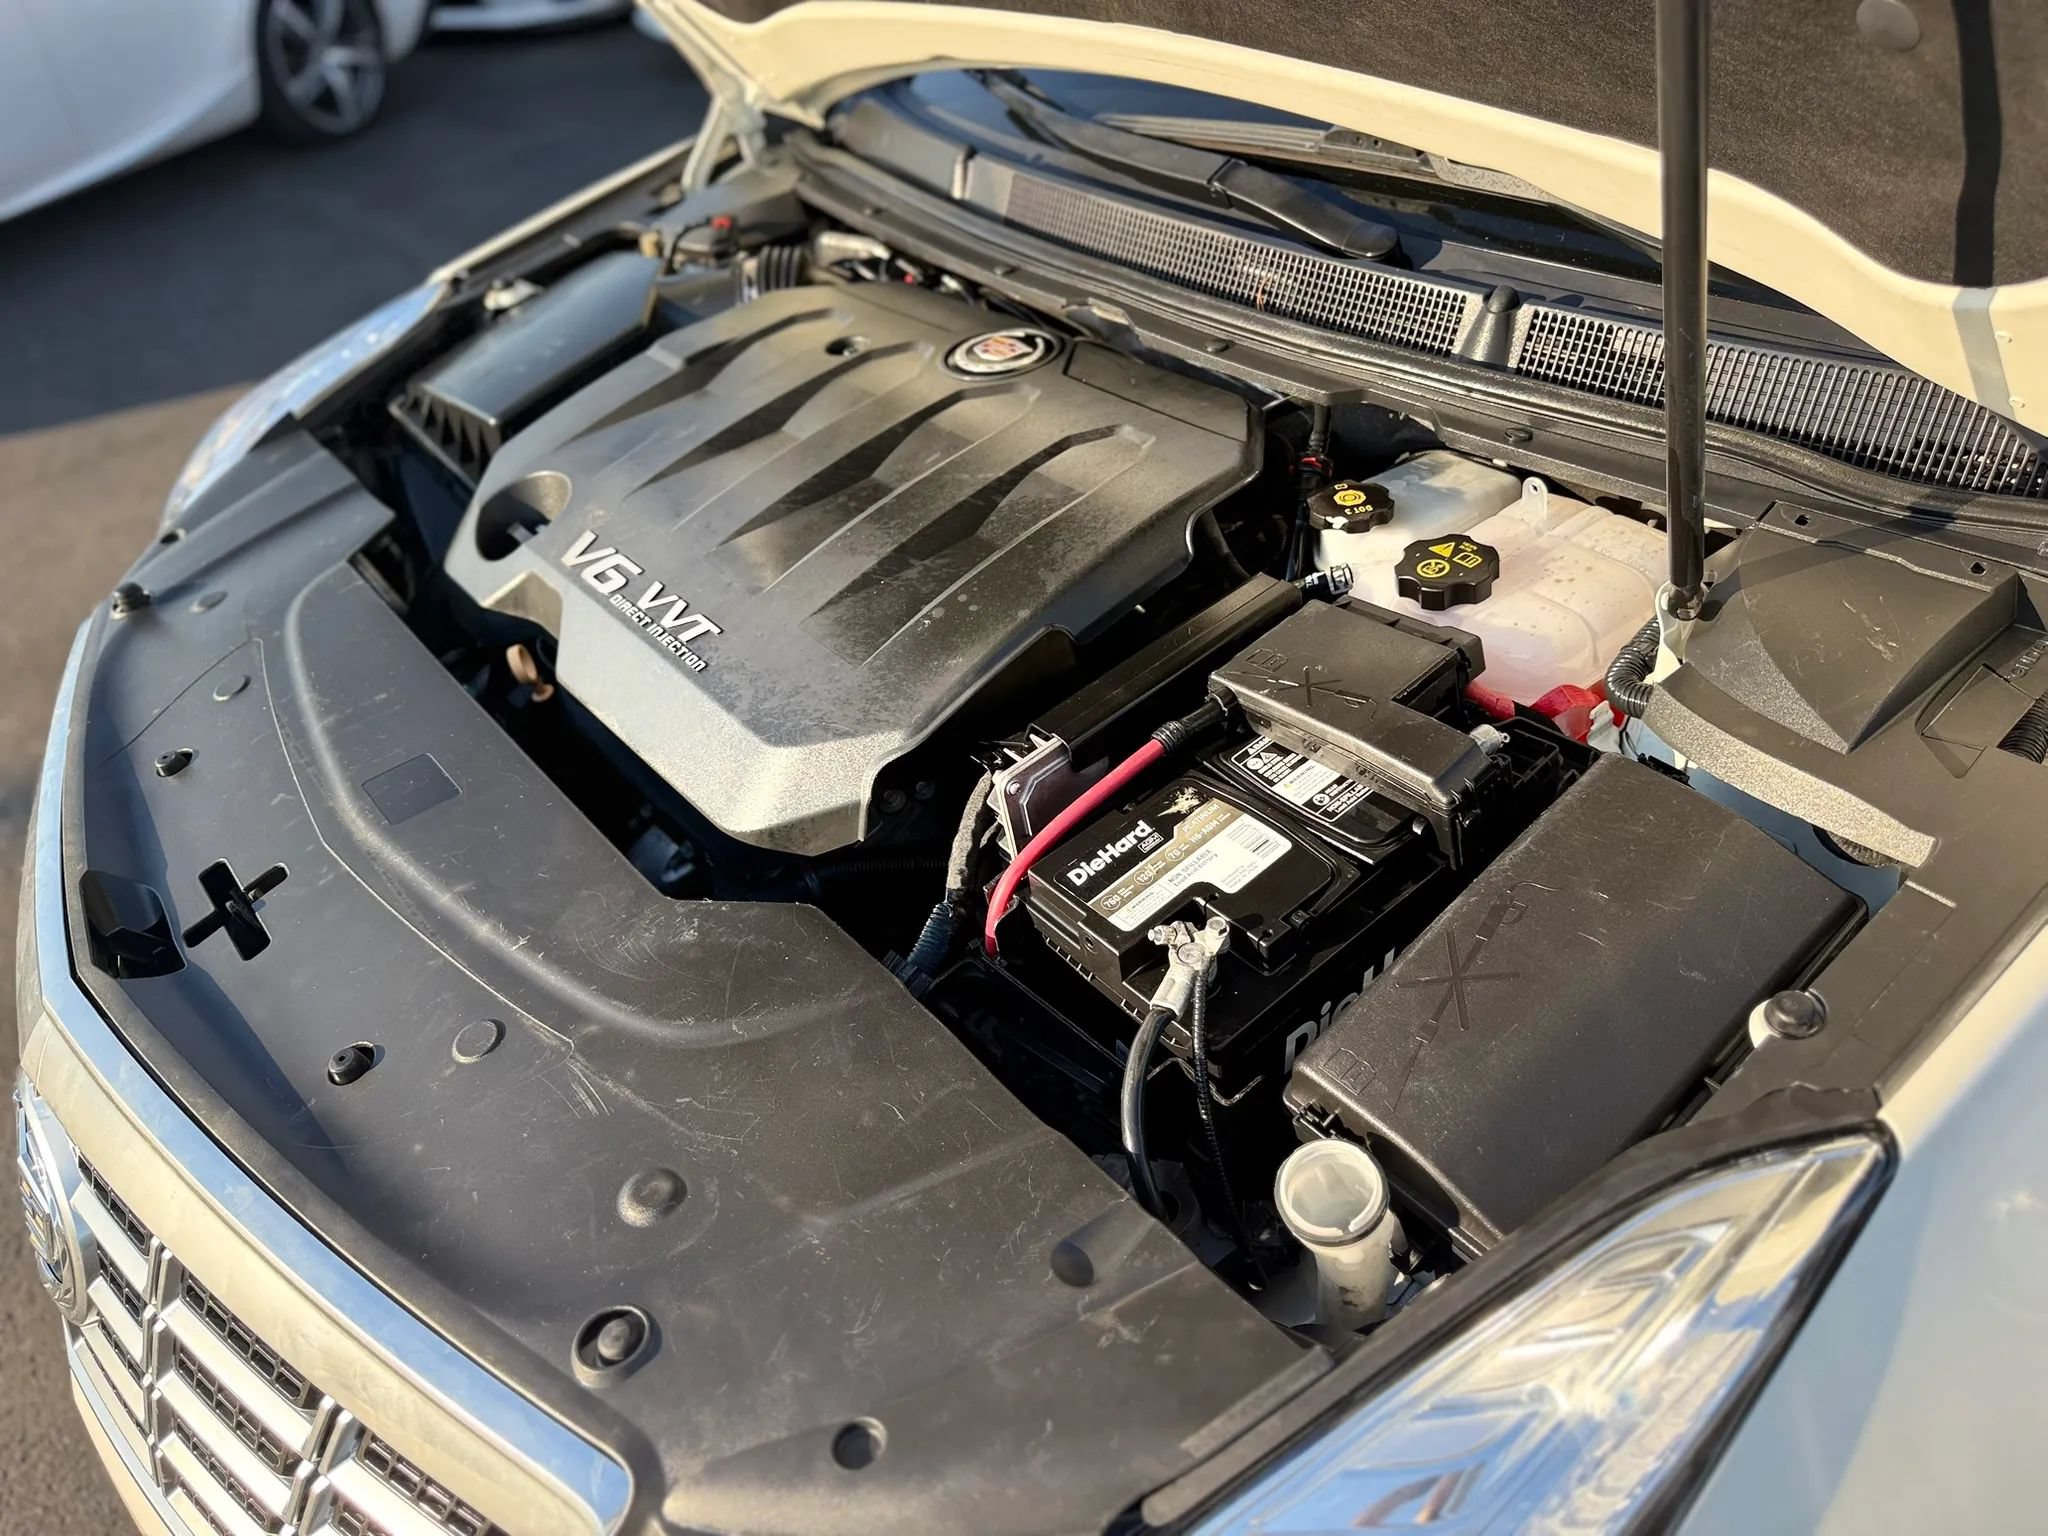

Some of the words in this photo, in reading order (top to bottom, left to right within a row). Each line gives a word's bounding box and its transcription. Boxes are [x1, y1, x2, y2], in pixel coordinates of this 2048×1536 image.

[1344, 507, 1352, 515] 3
[1354, 504, 1374, 514] DOT
[560, 529, 645, 595] V6
[636, 580, 724, 645] VVT
[609, 594, 653, 627] DIRECT
[646, 622, 708, 673] INJECTION
[1181, 803, 1220, 833] PLATINUM
[1066, 819, 1153, 887] DieHard
[1167, 849, 1181, 860] 70
[1103, 894, 1122, 908] 760
